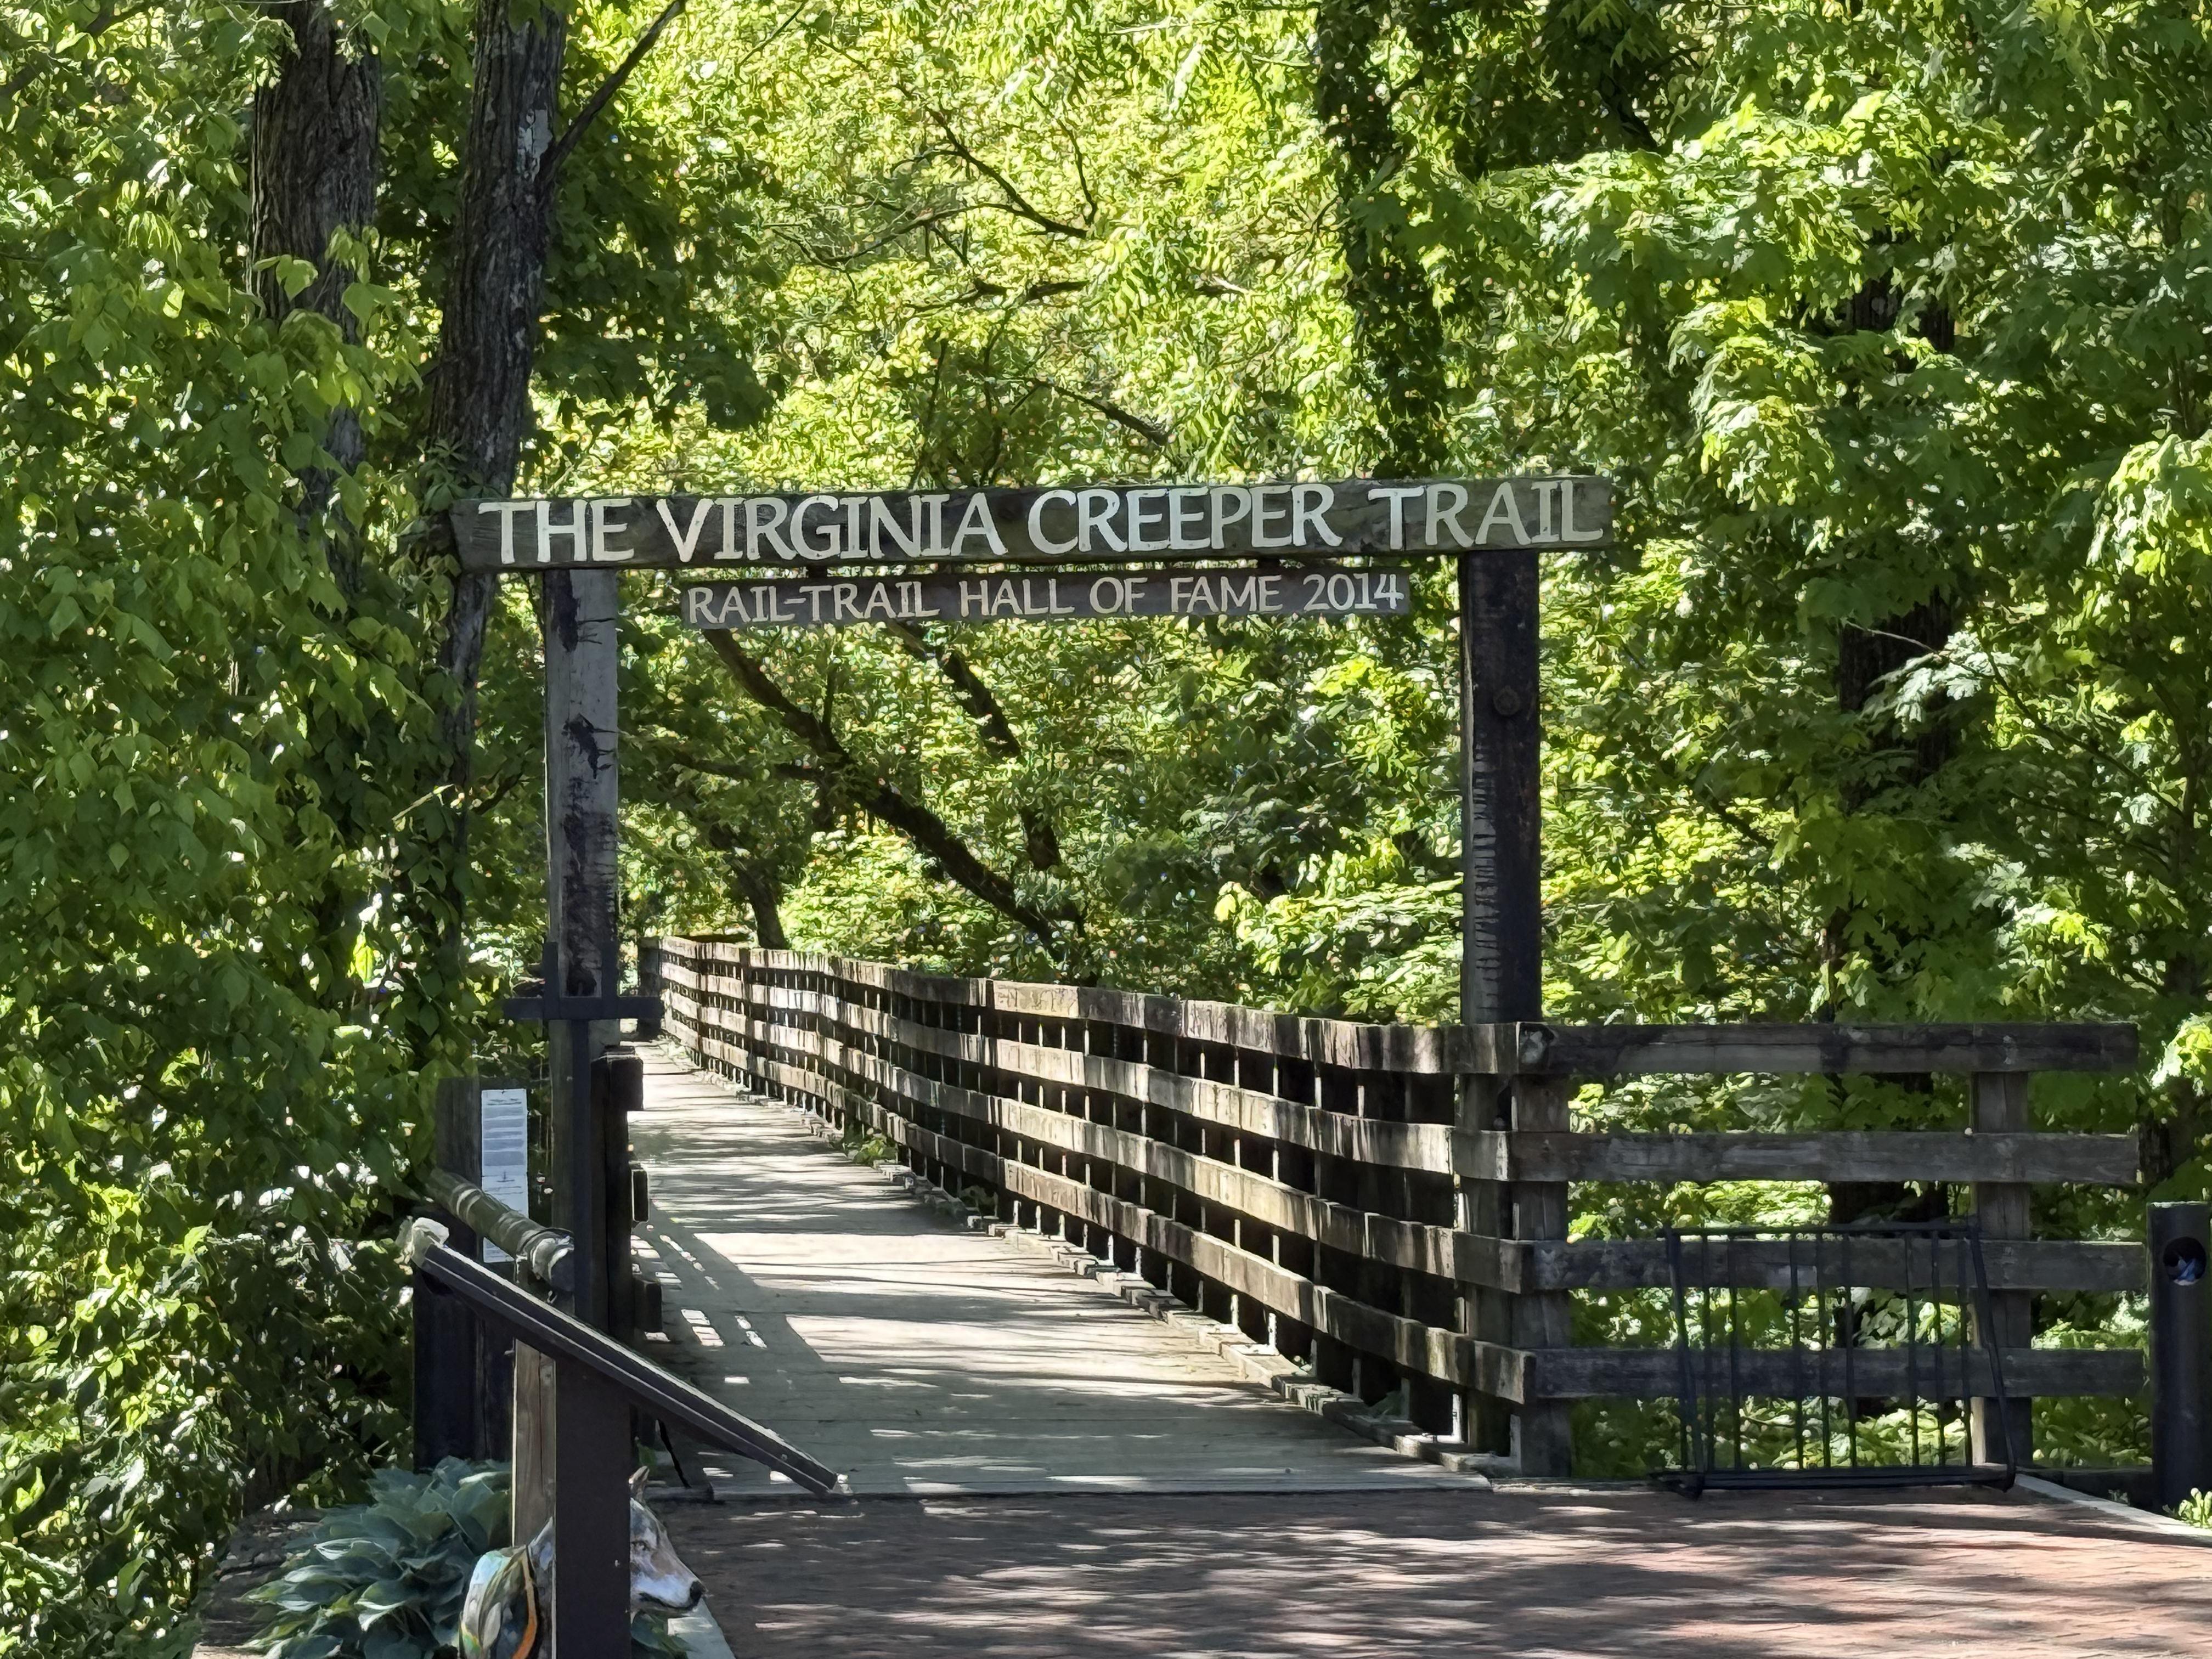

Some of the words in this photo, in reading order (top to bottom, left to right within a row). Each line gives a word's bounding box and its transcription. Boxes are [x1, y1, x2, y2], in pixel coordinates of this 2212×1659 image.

[478, 498, 634, 564] THE
[657, 492, 1008, 563] VIRGINIA
[1028, 483, 1343, 552] CREEPER
[1368, 479, 1603, 550] TRAIL
[687, 581, 939, 624] RAIL-TRAIL
[959, 576, 1074, 618] HALL
[1089, 576, 1147, 614] OF
[1170, 575, 1283, 613] FAME
[1303, 572, 1405, 611] 2014
